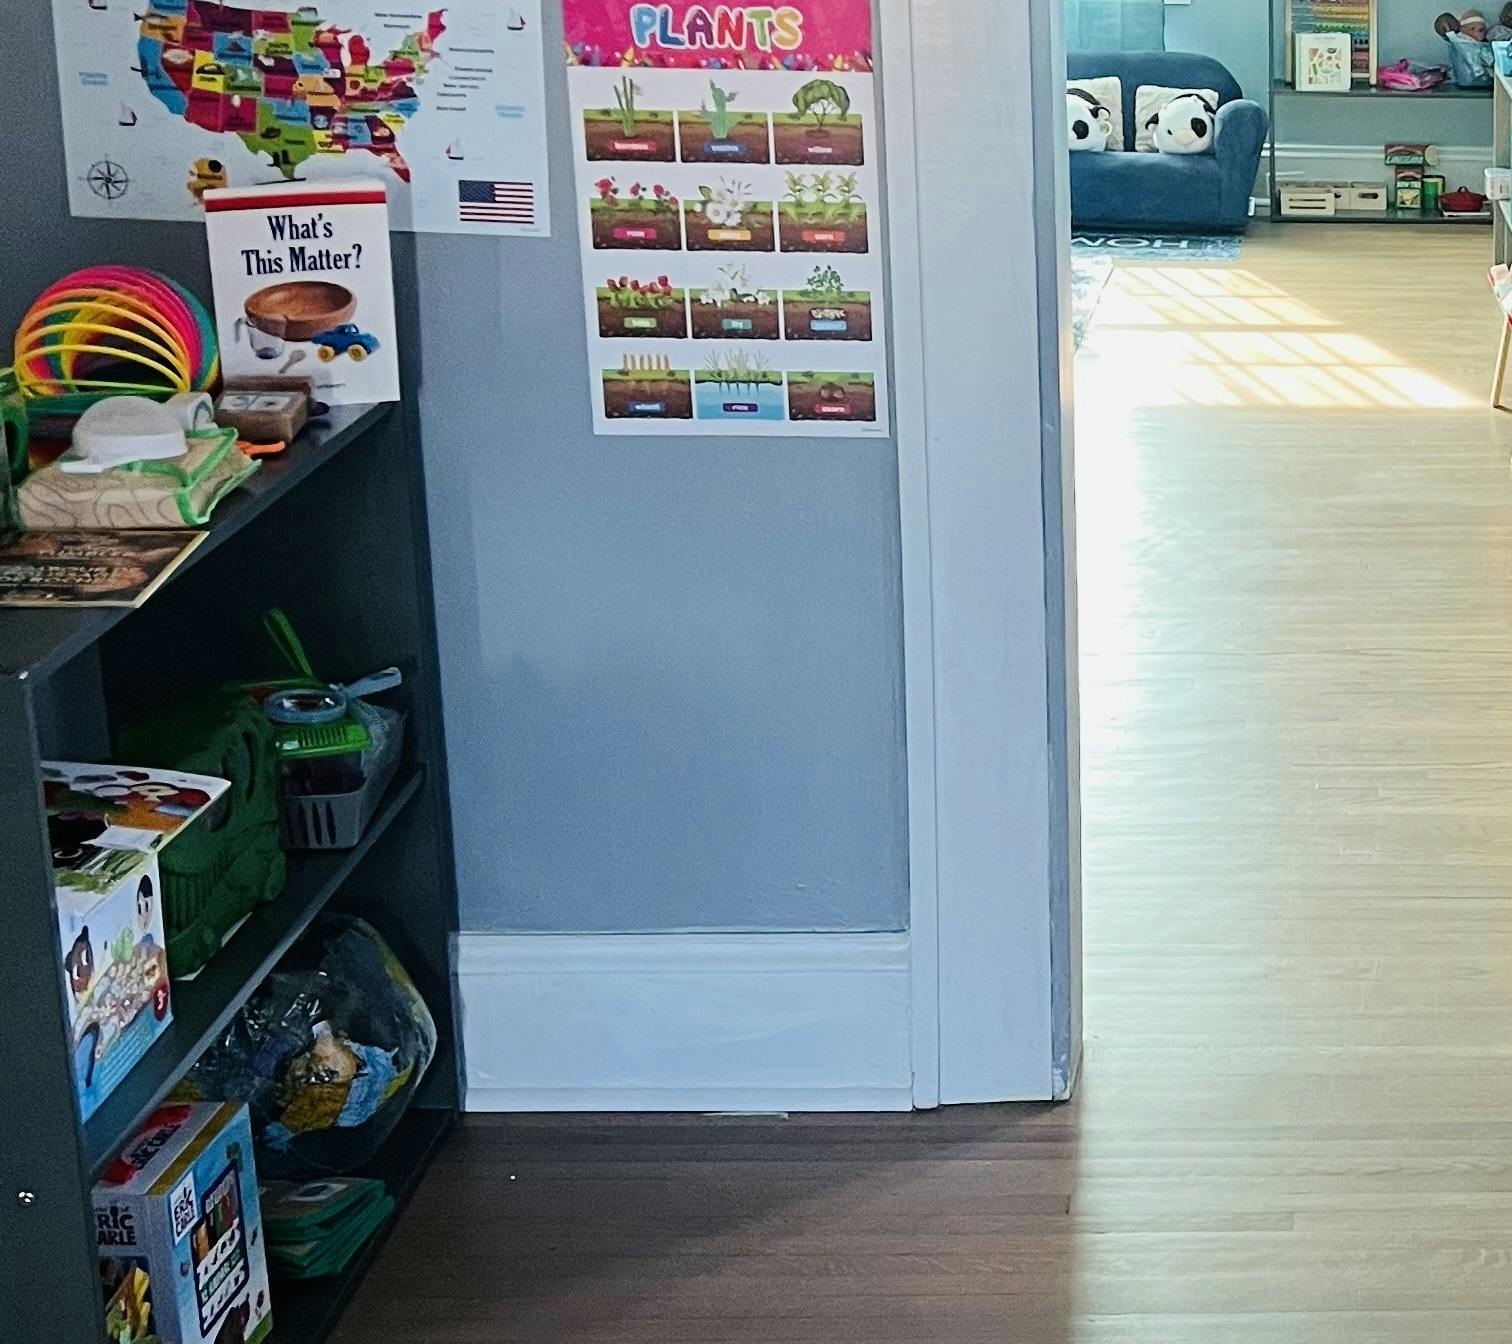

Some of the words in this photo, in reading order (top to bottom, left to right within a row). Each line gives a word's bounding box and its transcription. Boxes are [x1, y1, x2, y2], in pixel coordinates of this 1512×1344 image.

[630, 3, 803, 52] PLANTS
[267, 213, 333, 241] What's
[241, 249, 283, 276] This
[288, 243, 362, 272] Matter?
[97, 1205, 135, 1231] RIC
[97, 1229, 136, 1246] ARLE
